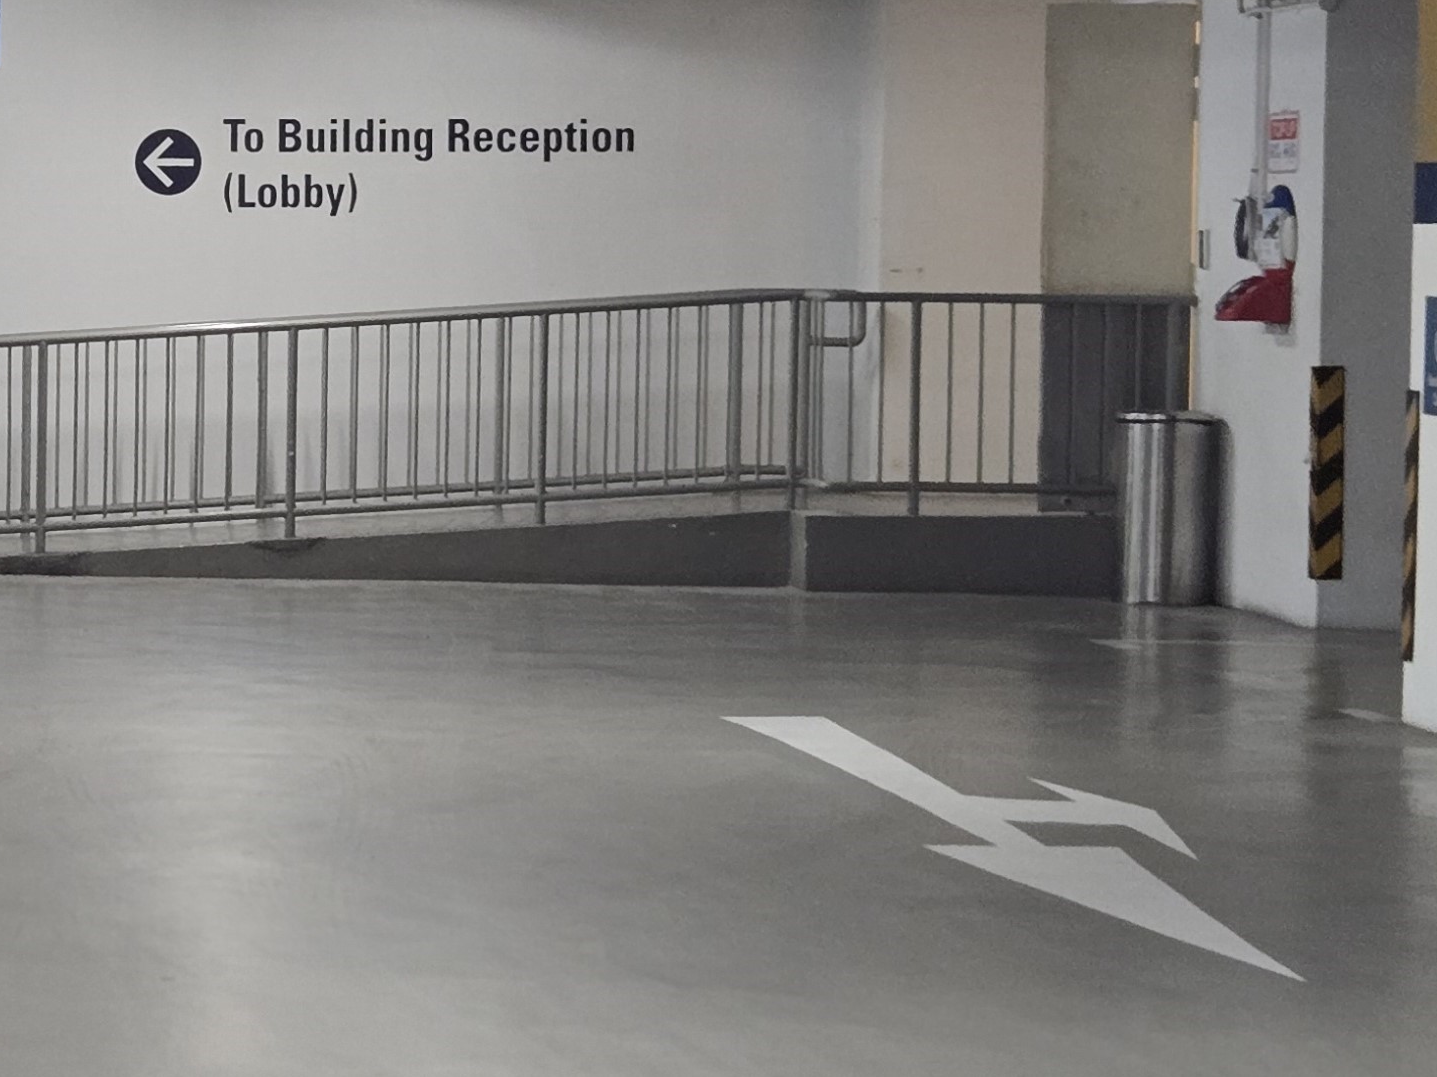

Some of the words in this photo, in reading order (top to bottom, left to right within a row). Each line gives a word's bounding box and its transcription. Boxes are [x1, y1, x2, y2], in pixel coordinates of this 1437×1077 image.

[222, 118, 264, 153] To
[278, 118, 434, 162] Building
[448, 118, 635, 163] Reception
[223, 172, 358, 217] (Lobby)
